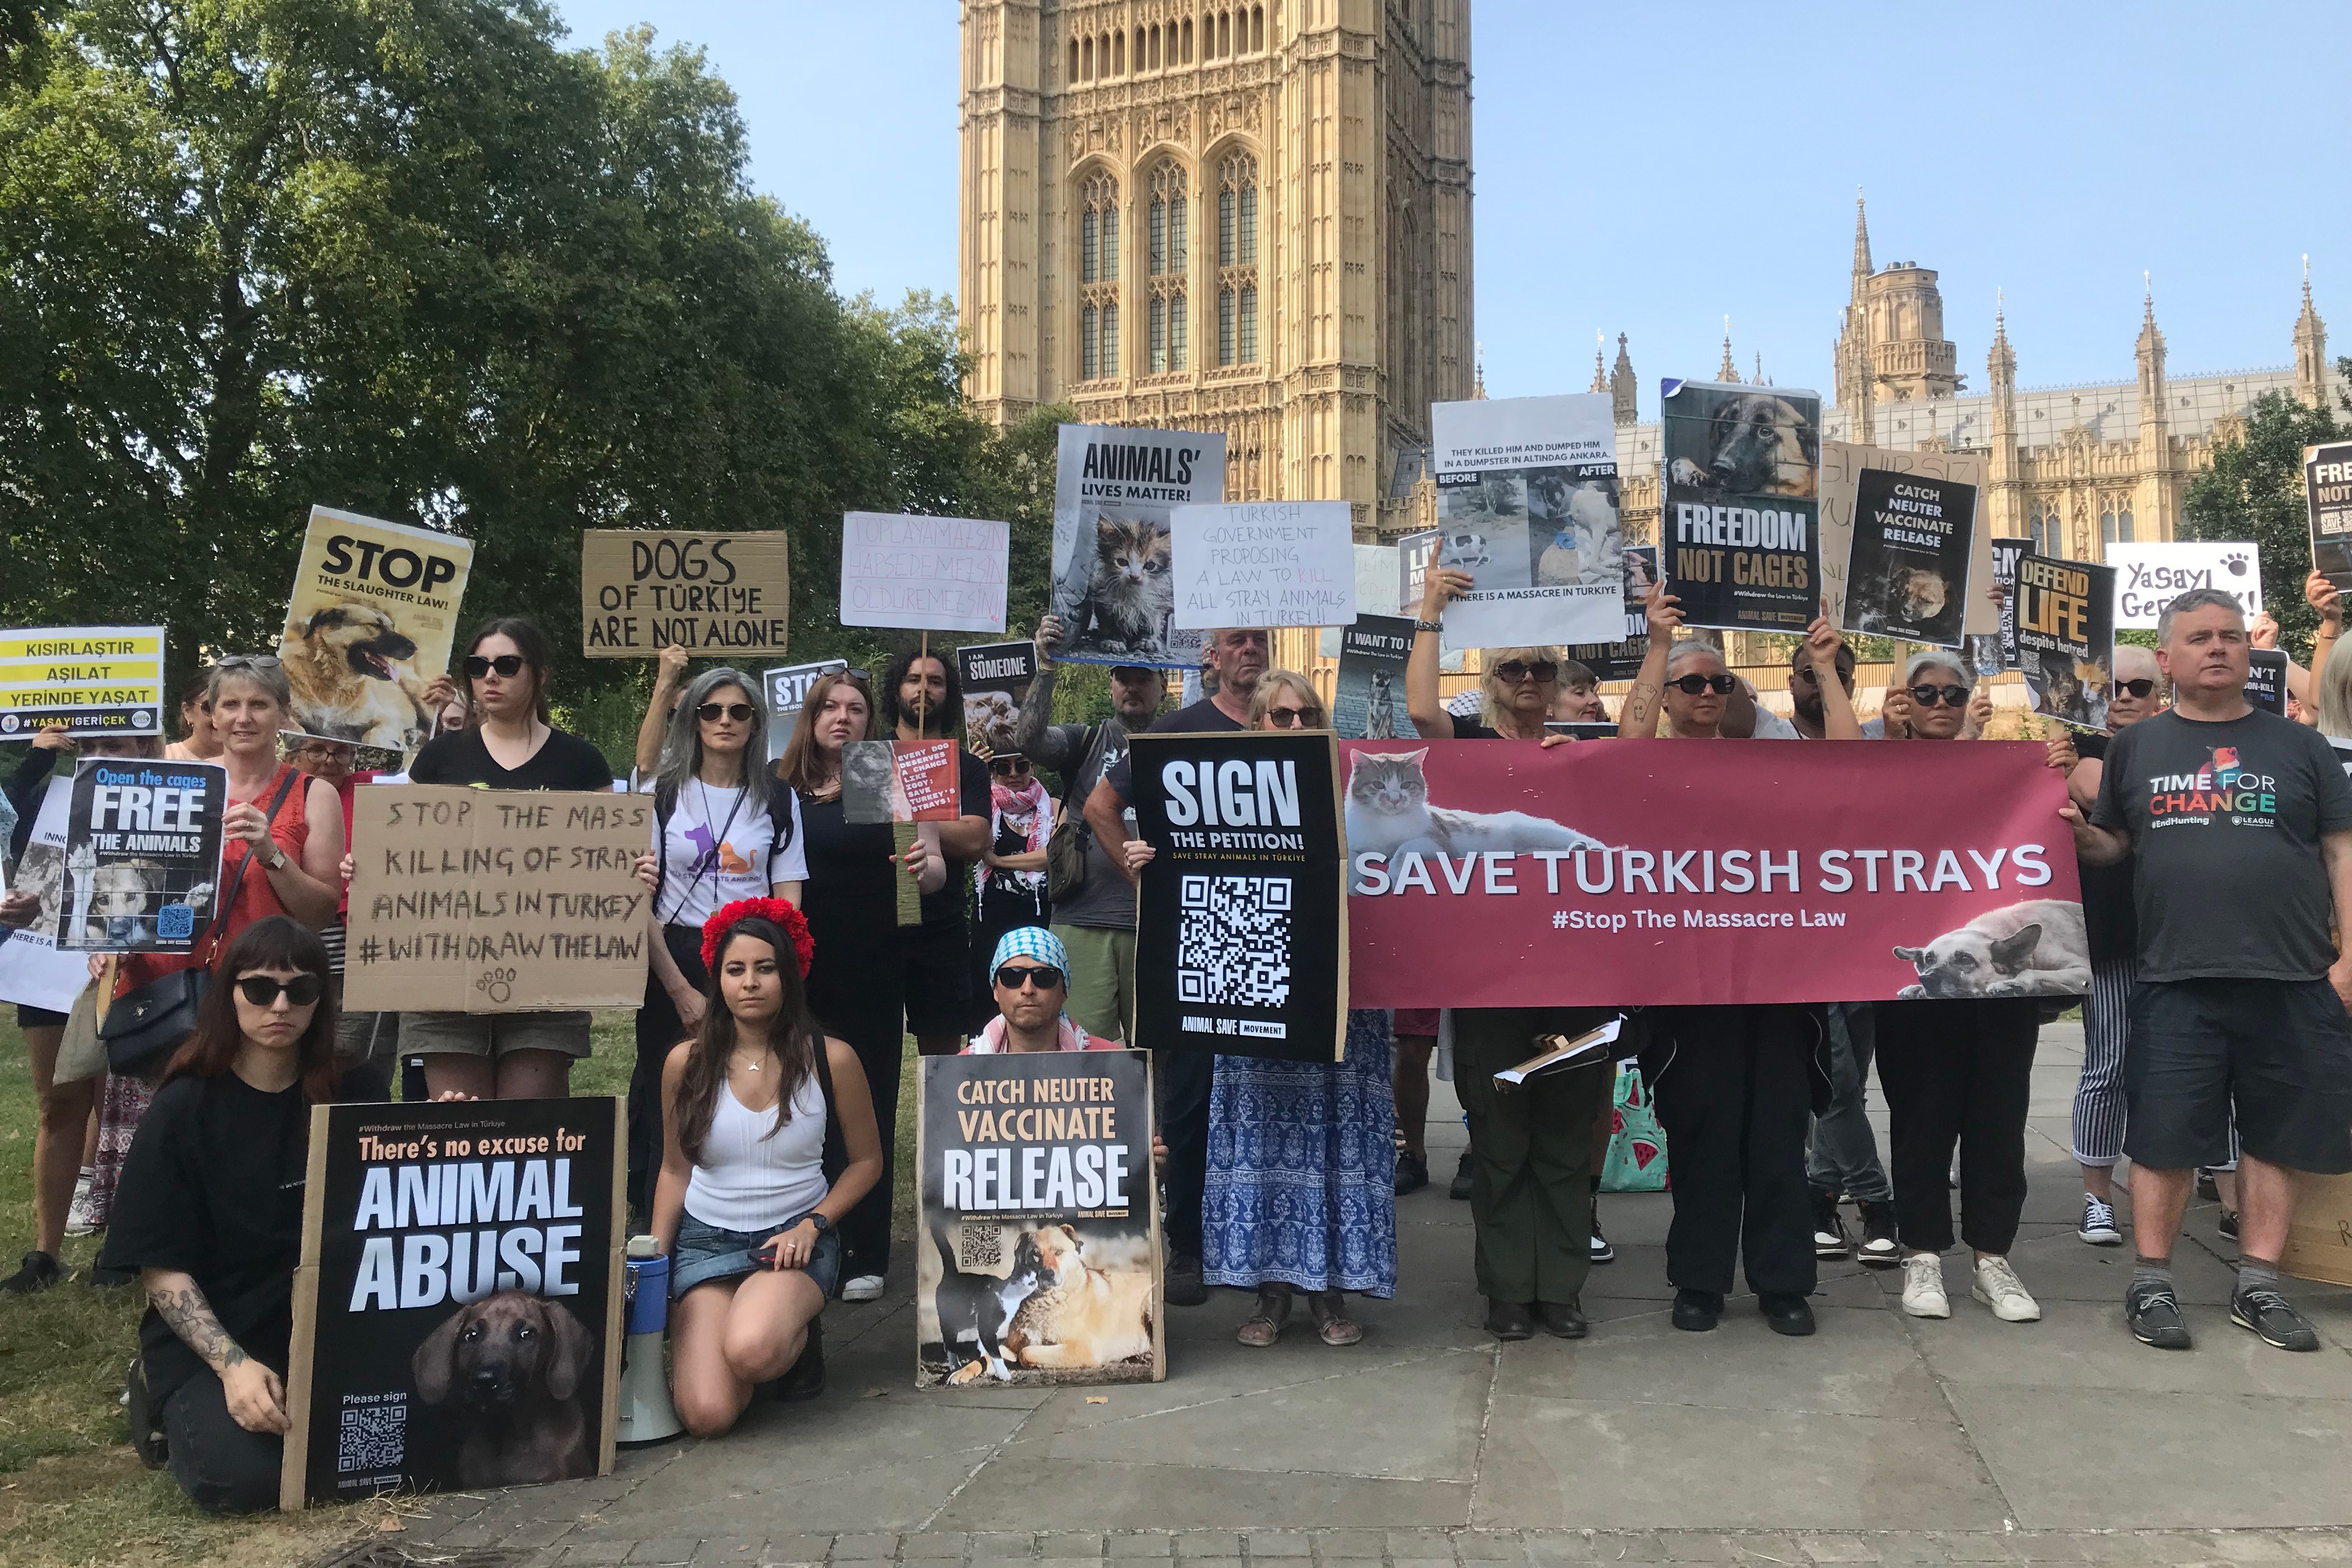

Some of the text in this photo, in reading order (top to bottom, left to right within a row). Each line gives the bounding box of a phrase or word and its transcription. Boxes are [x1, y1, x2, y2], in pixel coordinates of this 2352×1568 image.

[1451, 441, 1601, 457] THEY KILLED HIM AND DUMPED HIM
[1083, 443, 1201, 485] ANIMALS'
[1464, 457, 1511, 467] DUMPSTER
[1512, 456, 1521, 464] IN
[1523, 453, 1568, 463] ALTINDAG
[1569, 452, 1611, 461] ANKARA.
[1439, 464, 1616, 485] BEFORE AFTER
[1082, 484, 1191, 502] LIVES MATTER!
[1894, 484, 1940, 502] CATCH
[2318, 485, 2352, 503] NOT
[1224, 505, 1301, 523] TURKISH
[1888, 498, 1943, 517] NEUTER
[1677, 503, 1807, 552] FREEDOM
[1874, 510, 1954, 534] VACCINATE
[1203, 527, 1318, 544] GOVERNMENT
[1883, 527, 1941, 548] RELEASE
[321, 535, 456, 593] STOP
[633, 538, 737, 584] DOGS
[1212, 547, 1300, 565] PROPOSING
[1196, 566, 1334, 585] A LAW TO KILL
[1677, 547, 1726, 584] NOT
[1734, 551, 1808, 589] CAGES
[2021, 559, 2090, 597] DEFEND
[318, 575, 340, 587] THE
[343, 580, 414, 603] SLAUGHTER
[416, 596, 449, 610] LAW!
[600, 585, 638, 611] OF
[1187, 590, 1346, 610] ALL STRAY ANIMALS
[1486, 592, 1496, 601] IS
[1497, 592, 1505, 600] A
[1507, 589, 1561, 600] MASSACRE
[1563, 588, 1573, 597] IN
[1575, 586, 1616, 596] TURKIYE
[1237, 611, 1251, 626] IN
[1738, 610, 1776, 621] ANIMAL SAVE
[2019, 584, 2088, 643] LIFE
[589, 617, 785, 648] ARE NOT ALONE
[1348, 632, 1352, 644] I
[1355, 633, 1388, 648] WANT
[1390, 637, 1404, 650] TO
[26, 642, 135, 657] KISIRLAŞTIR
[2020, 629, 2088, 658] despite hatred
[47, 666, 111, 683] AŞILAT
[970, 656, 1027, 680] SOMEONE
[10, 689, 149, 707] YERİNDE YAŞAT
[898, 749, 926, 761] EVERY
[900, 751, 946, 769] DESERVES
[913, 759, 948, 772] CHANCE
[96, 768, 206, 790] Open the cages
[904, 772, 927, 783] LIKE
[2150, 773, 2276, 794] TIME FOR
[908, 786, 932, 797] SAVE
[1162, 760, 1301, 827] SIGN
[90, 785, 205, 833] FREE
[912, 797, 951, 813] STRAYS!
[2150, 792, 2276, 815] CHANGE
[386, 801, 646, 830] STOP THE MASS
[2151, 817, 2210, 829] #EndHunting
[90, 833, 201, 852] THE ANIMALS
[1170, 832, 1304, 850] THE PETITION!
[386, 846, 645, 877] KILLING OF STRAY
[1172, 852, 1306, 862] SAVE STRAY ANIMALS IN TÜRKİYE
[1354, 844, 2052, 895] SAVE TURKISH STRAYS
[371, 889, 643, 922] ANIMALS IN TURKEY
[1552, 908, 1846, 933] #Stop The Massacre Law
[1182, 1016, 1282, 1035] ANIMAL SAVE MOVEMENT
[957, 1077, 1115, 1105] CATCH NEUTER
[958, 1107, 1116, 1142] VACCINATE
[358, 1127, 586, 1161] There's no excuse for
[944, 1145, 1129, 1211] RELEASE
[354, 1158, 583, 1231] ANIMAL
[349, 1225, 582, 1312] ABUSE
[342, 1391, 407, 1405] Please sign
[338, 1478, 358, 1489] ANIMAL
[359, 1478, 372, 1486] SAVE
